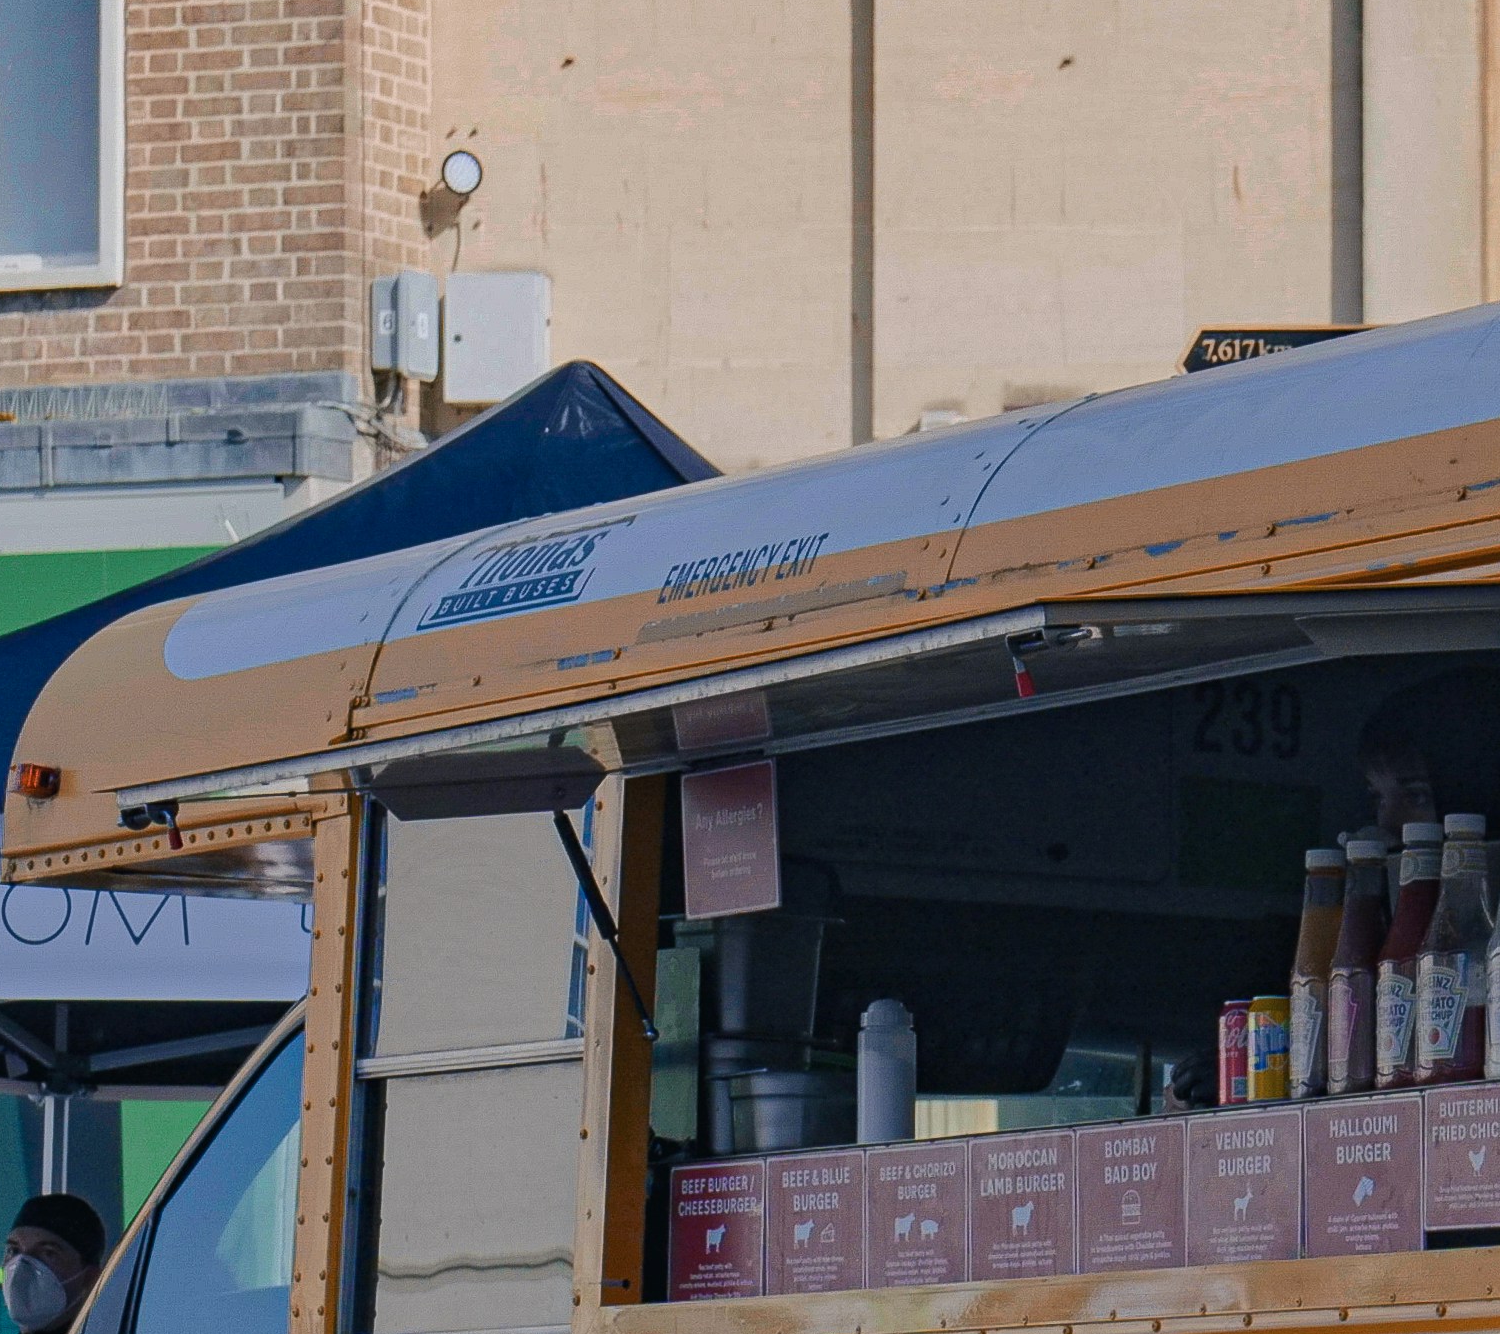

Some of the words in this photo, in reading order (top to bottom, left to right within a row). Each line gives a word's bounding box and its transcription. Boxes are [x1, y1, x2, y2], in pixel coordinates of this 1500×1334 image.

[1202, 338, 1256, 363] 7.617
[656, 544, 777, 605] EMERGENCY
[775, 531, 830, 581] EXIT
[437, 584, 500, 619] BUILT
[501, 570, 576, 606] BUSES
[694, 812, 713, 831] Any
[1329, 1114, 1398, 1138] HALLOUMI
[1432, 1124, 1466, 1142] FRIED
[1104, 1136, 1157, 1159] BOMBAY
[1215, 1127, 1275, 1151] VENISON
[988, 1147, 1058, 1171] MOROCCAN
[1336, 1142, 1392, 1165] BURGER
[879, 1165, 903, 1182] BEEF
[1104, 1164, 1130, 1185] BAD
[1132, 1161, 1158, 1182] BOY
[1218, 1154, 1271, 1177] BURGER
[681, 1178, 706, 1195] BEEF
[782, 1169, 810, 1189] BEEF
[811, 1168, 819, 1186] &
[821, 1166, 851, 1185] BLUE
[980, 1176, 1013, 1197] LAMB
[1016, 1172, 1066, 1195] BURGER
[793, 1191, 839, 1212] BURGER
[897, 1183, 937, 1200] BURGER
[677, 1196, 758, 1217] CHEESEBURGER
